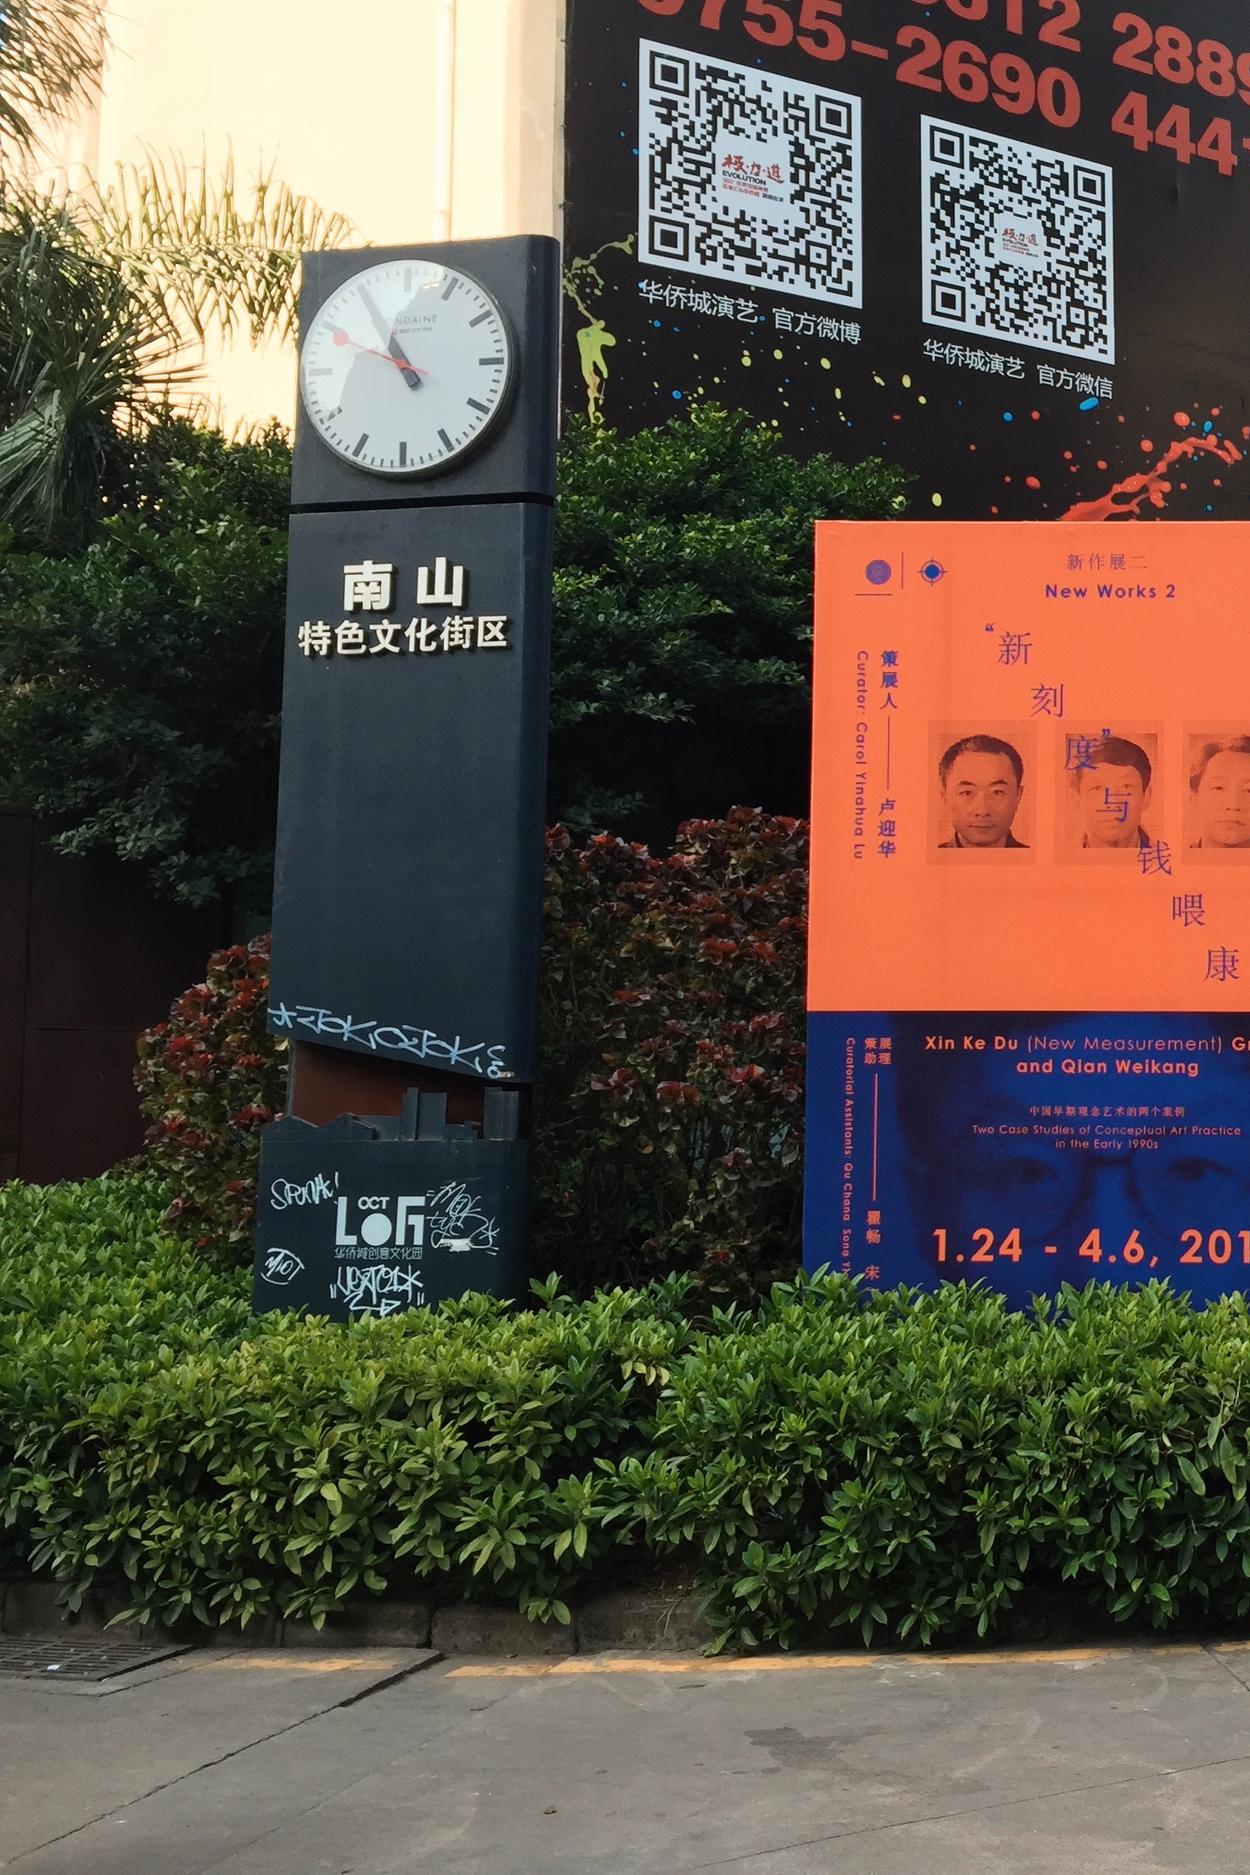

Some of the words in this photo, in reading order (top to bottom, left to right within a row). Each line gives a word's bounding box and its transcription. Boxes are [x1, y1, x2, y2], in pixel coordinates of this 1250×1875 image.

[639, 0, 1081, 128] 755-2690
[638, 279, 759, 324] 华侨城演艺
[772, 307, 862, 345] 官方微博
[923, 338, 1025, 380] 华侨城演艺
[1036, 364, 1114, 400] 官方微信
[1067, 554, 1147, 570] 新作展二
[343, 556, 466, 613] 南山
[1045, 585, 1087, 598] New
[1097, 585, 1157, 598] Works
[1166, 585, 1175, 598] 2
[298, 615, 508, 656] 特色文化街区
[880, 650, 899, 710] 策展人
[855, 722, 868, 765] Carol
[877, 797, 897, 859] 卢迎华
[853, 844, 866, 860] Lu
[925, 1036, 955, 1050] Xin
[963, 1036, 986, 1050] Ke
[994, 1036, 1019, 1050] Du
[1028, 1036, 1075, 1053] (New
[1083, 1036, 1223, 1054] Measurement)
[1016, 1059, 1053, 1074] and
[1061, 1059, 1107, 1074] Qian
[1115, 1059, 1199, 1077] Weikang
[1029, 1105, 1186, 1118] 中国早期观念艺术的两个案例
[972, 1124, 995, 1135] Two
[999, 1124, 1029, 1135] Case
[1033, 1124, 1075, 1135] Studies
[1079, 1124, 1091, 1135] of
[1096, 1125, 1166, 1137] Conceptual
[1170, 1125, 1188, 1136] Art
[1192, 1125, 1241, 1136] Practice
[1055, 1139, 1067, 1149] in
[1070, 1139, 1089, 1149] the
[1094, 1139, 1124, 1152] Early
[1128, 1139, 1159, 1150] 1990s
[357, 1196, 390, 1210] OCT
[334, 1247, 423, 1260] 华侨城创意文化园
[933, 1227, 1023, 1263] 1.24
[1078, 1227, 1159, 1267] 4.6,
